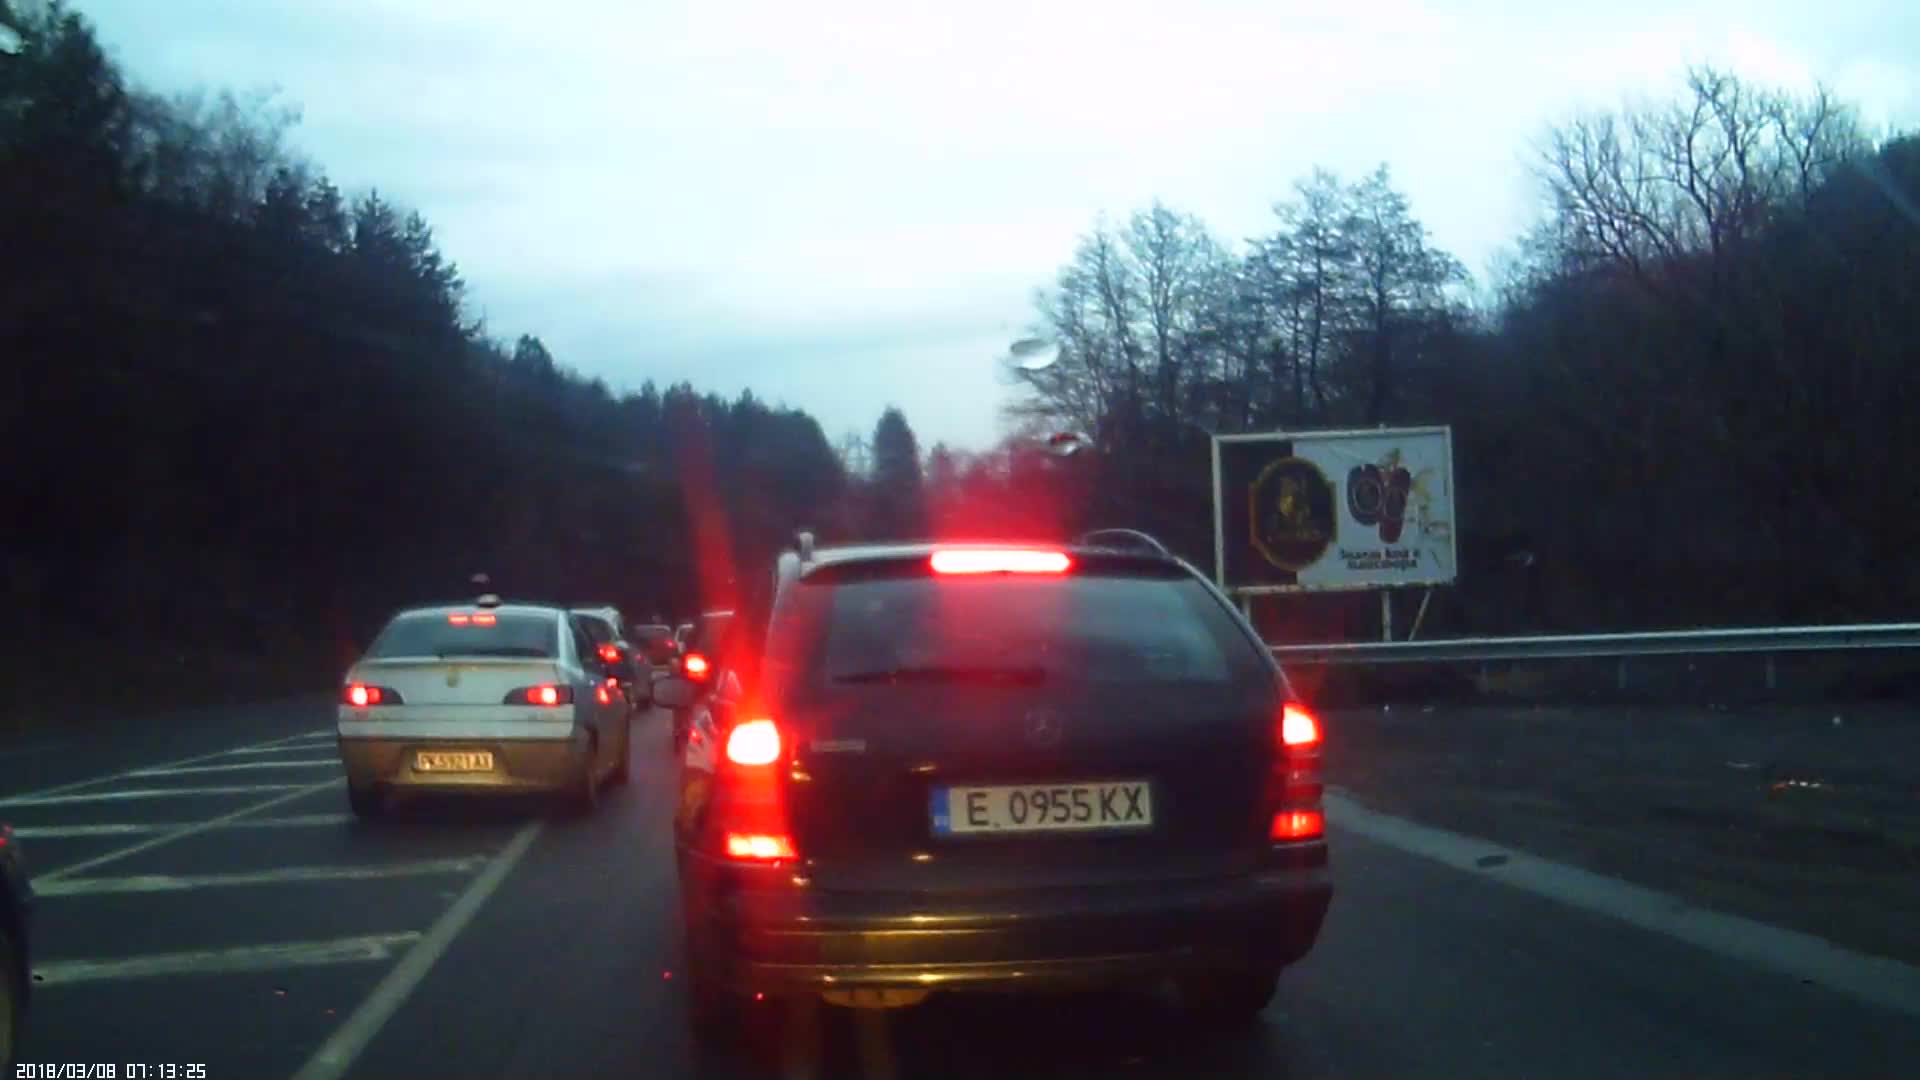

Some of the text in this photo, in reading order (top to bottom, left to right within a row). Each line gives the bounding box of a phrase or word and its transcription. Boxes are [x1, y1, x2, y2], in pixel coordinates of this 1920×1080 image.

[966, 786, 1144, 826] E 0955 KX
